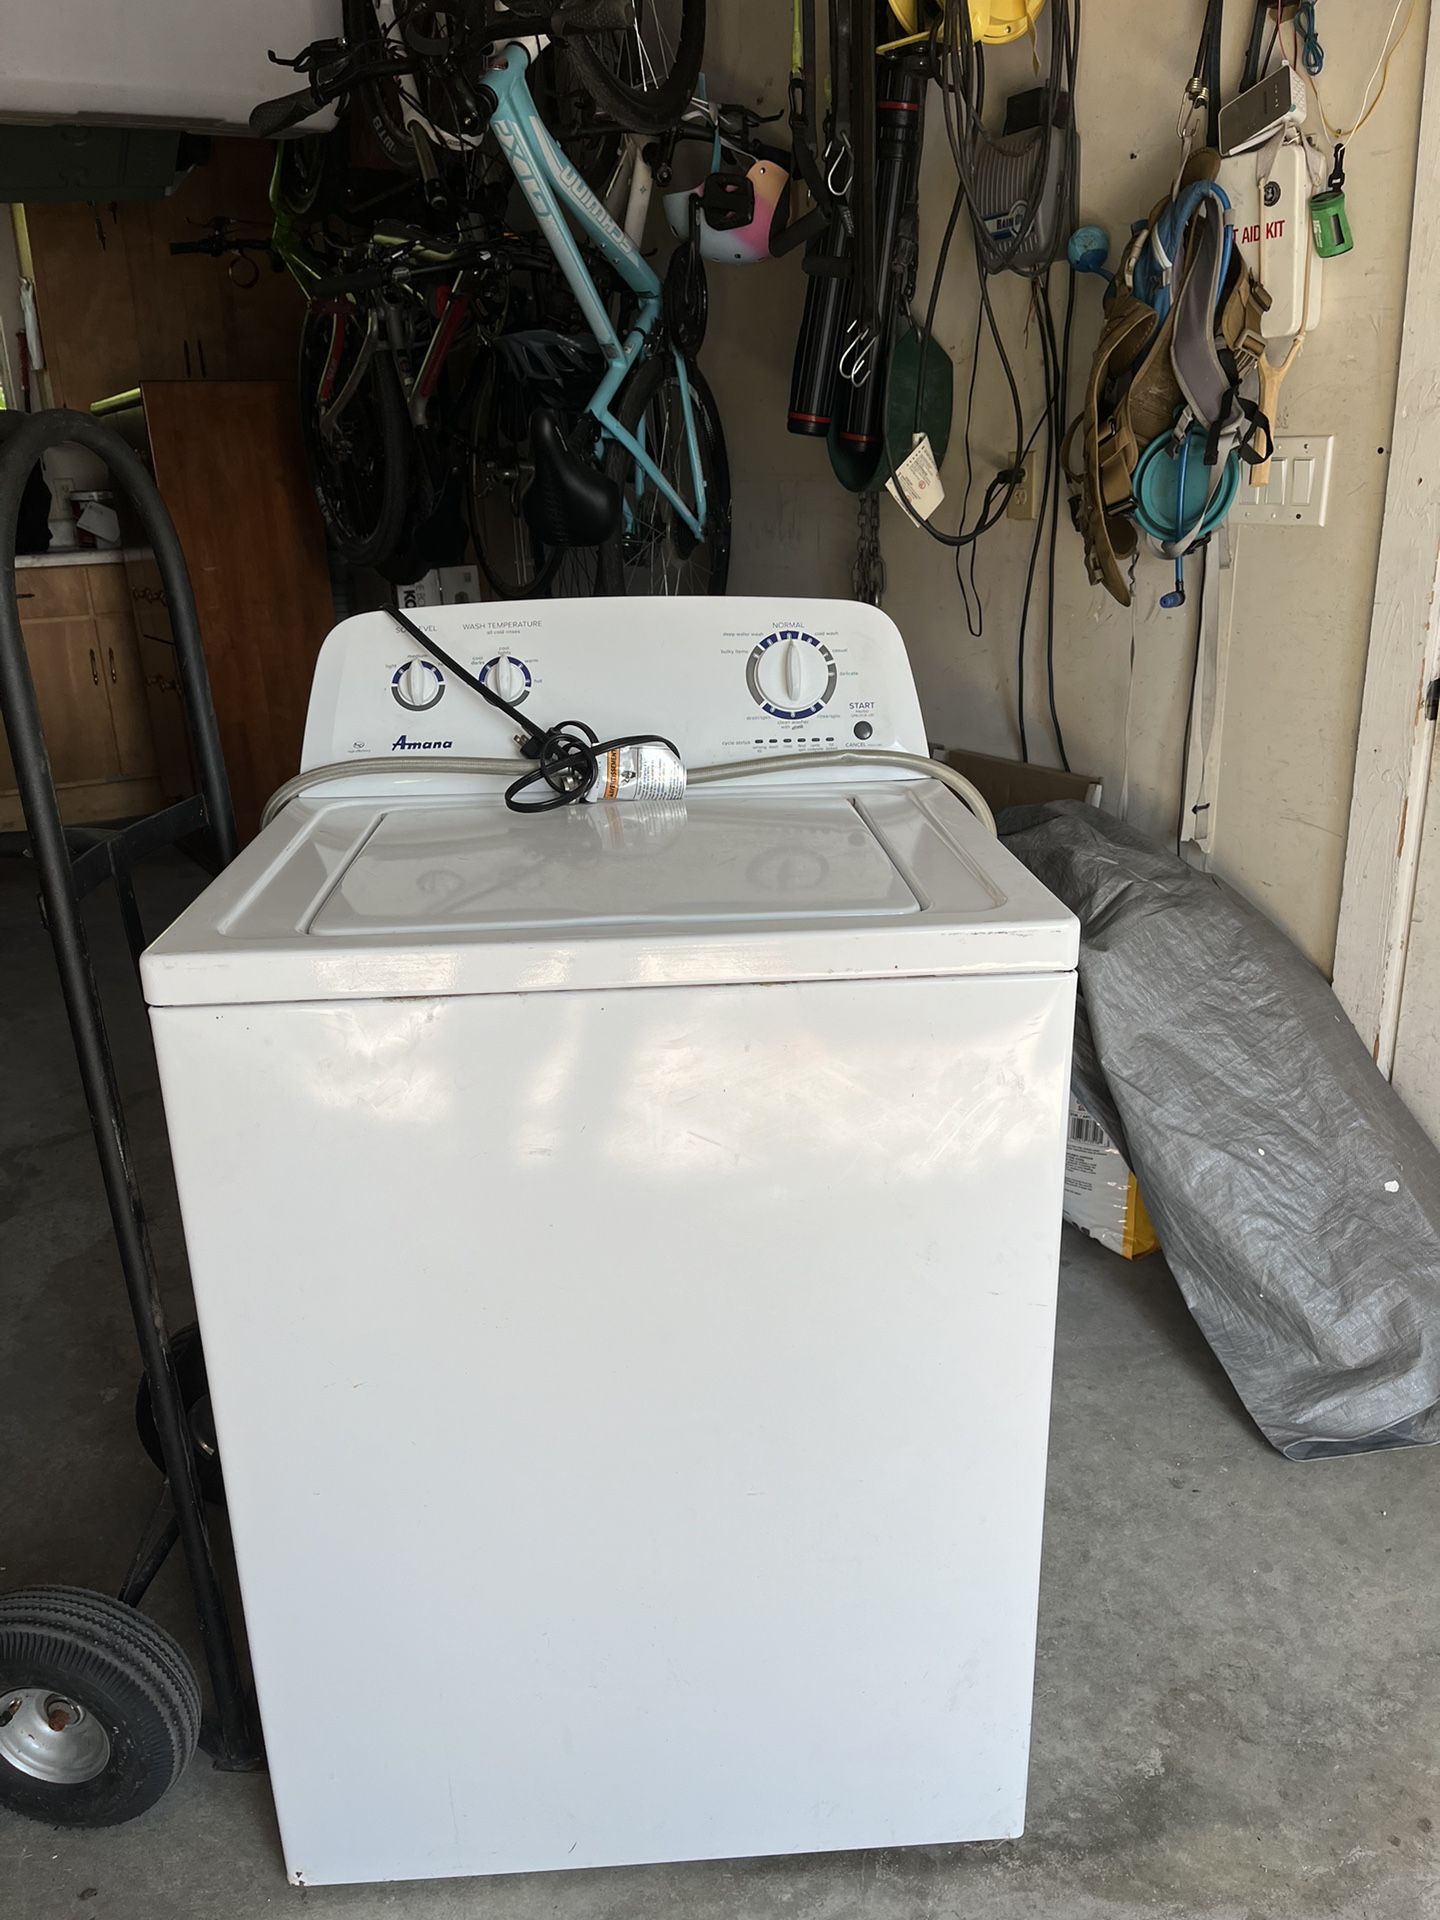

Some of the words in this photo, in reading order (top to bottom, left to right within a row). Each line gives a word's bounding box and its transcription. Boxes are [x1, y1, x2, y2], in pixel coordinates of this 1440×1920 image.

[560, 166, 633, 254] SCHWINN
[1241, 224, 1260, 244] AID
[1265, 219, 1285, 238] KIT
[463, 622, 485, 630] WASH
[487, 620, 542, 629] TEMPERATURE
[391, 735, 453, 751] Amana
